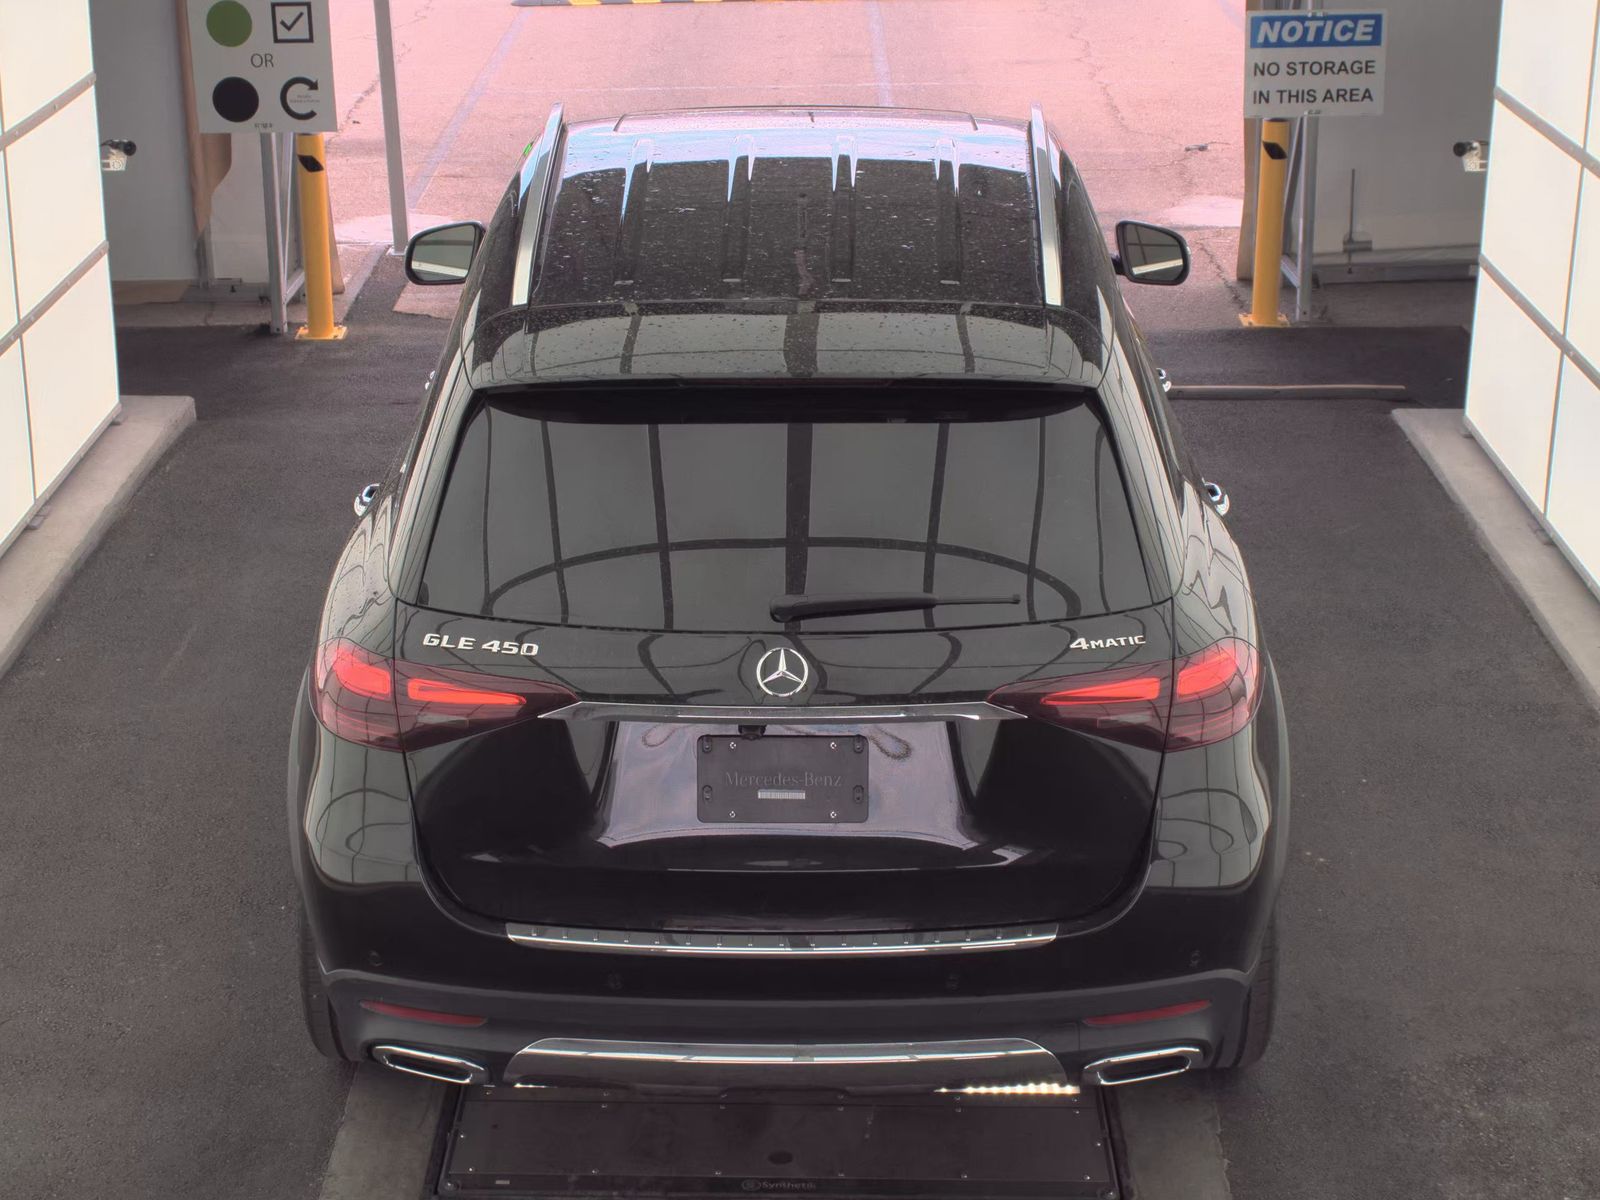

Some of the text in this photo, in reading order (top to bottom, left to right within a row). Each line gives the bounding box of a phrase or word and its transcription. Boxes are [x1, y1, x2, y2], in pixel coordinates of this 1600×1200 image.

[1256, 19, 1376, 44] NOTICE
[250, 53, 275, 69] OR
[1253, 59, 1377, 77] NO STORAGE
[1253, 88, 1375, 105] IN THIS AREA
[422, 633, 540, 657] GLE 450
[1069, 635, 1147, 650] 4MATIC
[725, 771, 843, 788] Mercedes-Benz
